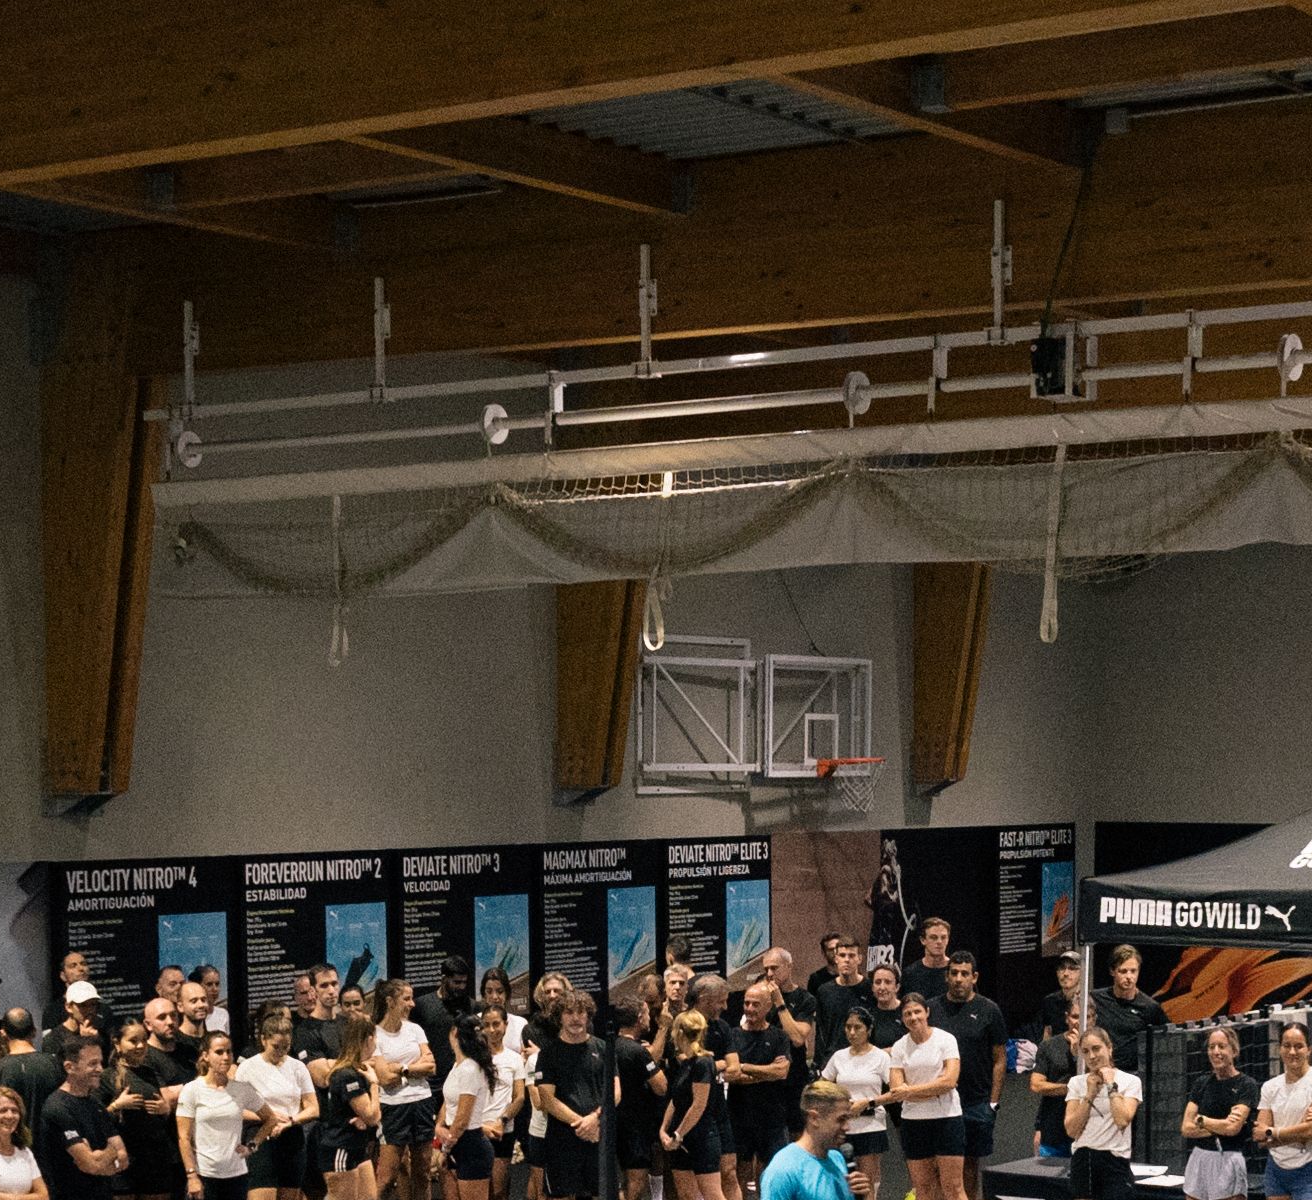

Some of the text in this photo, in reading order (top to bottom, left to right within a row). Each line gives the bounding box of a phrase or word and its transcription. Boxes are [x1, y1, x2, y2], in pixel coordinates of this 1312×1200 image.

[1050, 829, 1067, 845] ELITE
[543, 849, 586, 871] MAGMAX
[668, 844, 704, 866] DEVIATE
[740, 842, 761, 861] ELITE
[763, 843, 769, 860] 3
[245, 861, 324, 886] FOREVERRUN
[374, 858, 382, 879] 2
[403, 855, 447, 878] DEVIATE
[493, 853, 500, 873] 3
[668, 864, 750, 878] PROPULSIÓN Y LIGEREZA
[67, 869, 134, 894] VELOCITY
[188, 866, 197, 888] 4
[403, 879, 451, 894] VELOCIDAD
[543, 871, 573, 886] MÁXIMA
[67, 892, 155, 912] AMORTIGUACIÓN
[245, 886, 307, 902] ESTABILIDAD
[1099, 896, 1173, 927] PUMA
